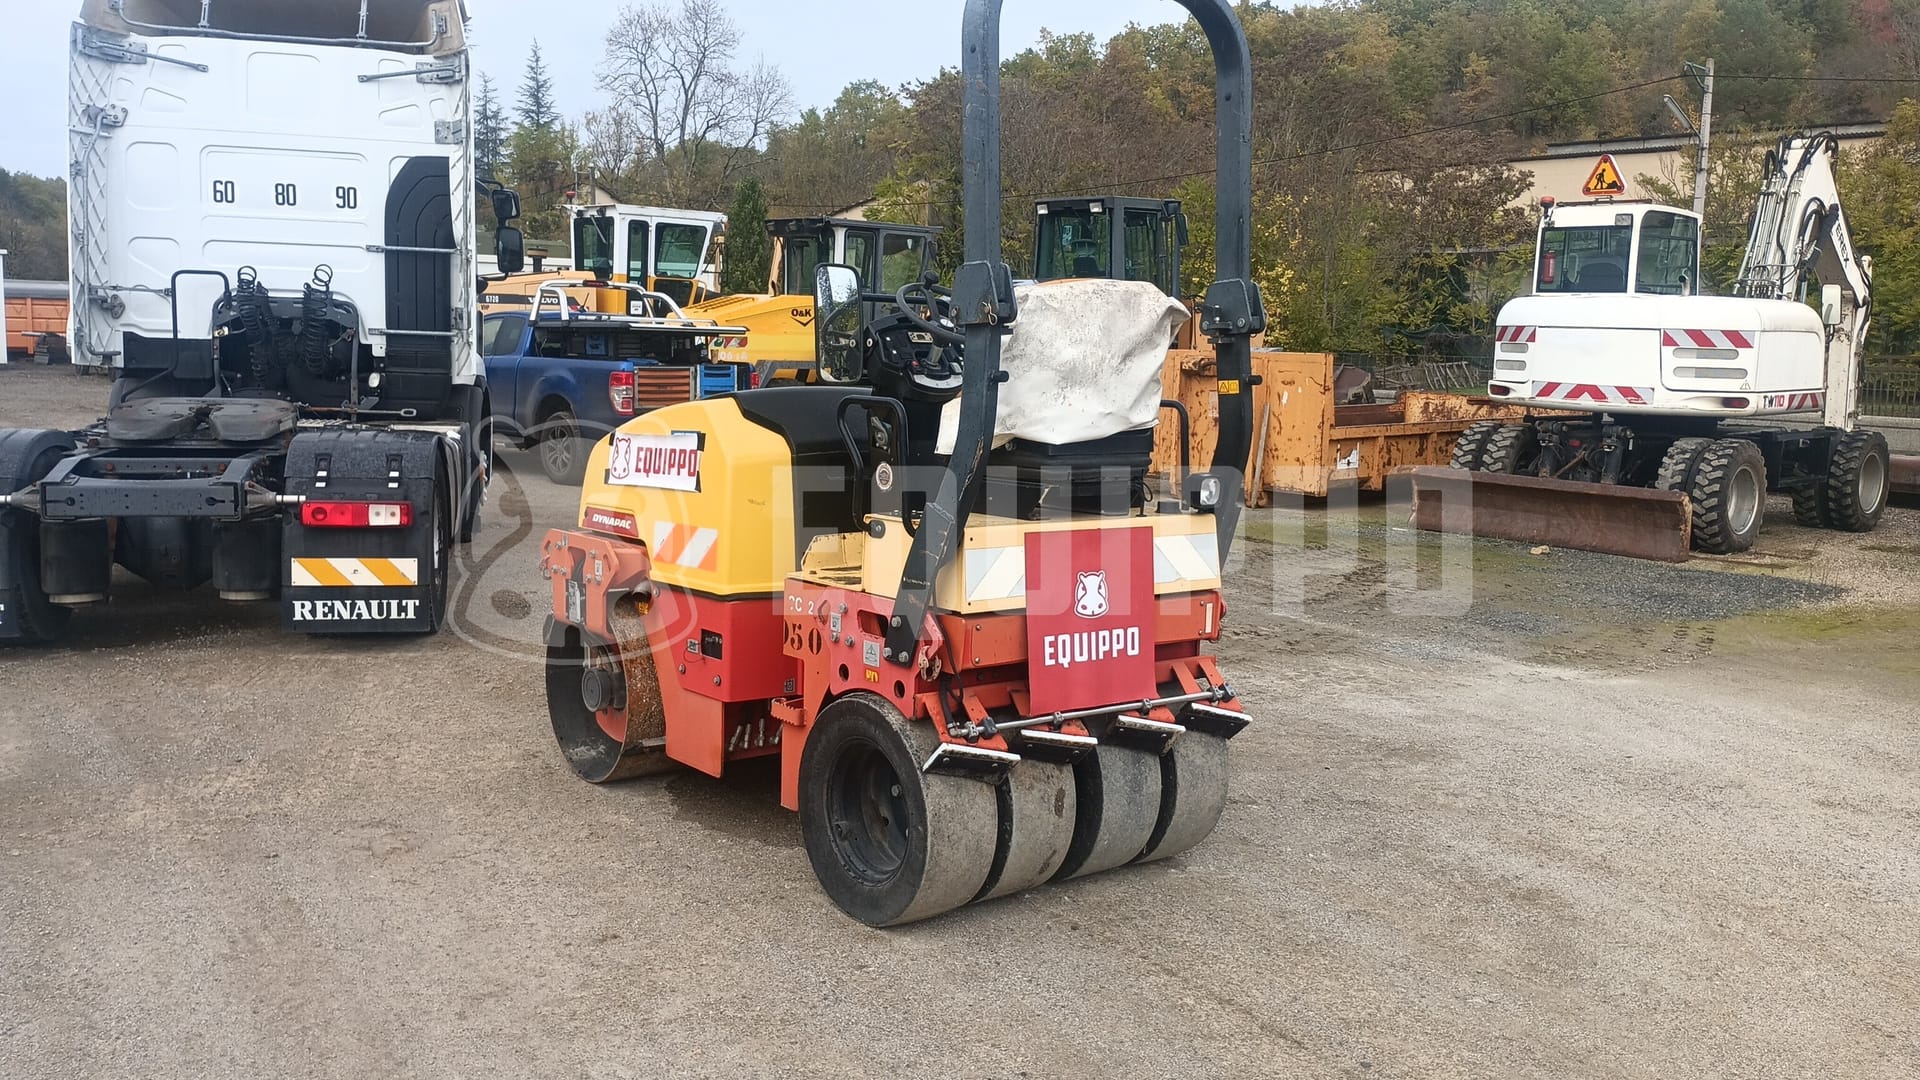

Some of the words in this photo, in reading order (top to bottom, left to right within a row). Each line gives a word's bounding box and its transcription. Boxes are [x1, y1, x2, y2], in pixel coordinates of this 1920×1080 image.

[213, 180, 235, 204] 60
[275, 183, 297, 207] 80
[336, 186, 358, 209] 90
[1831, 222, 1850, 269] EREX
[528, 296, 559, 304] VLVO
[791, 308, 812, 318] O&K
[635, 446, 698, 478] EQUIPPO
[592, 513, 632, 530] DYNAPAC
[292, 599, 420, 621] RENAULT
[1043, 626, 1140, 669] EQUIPPO
